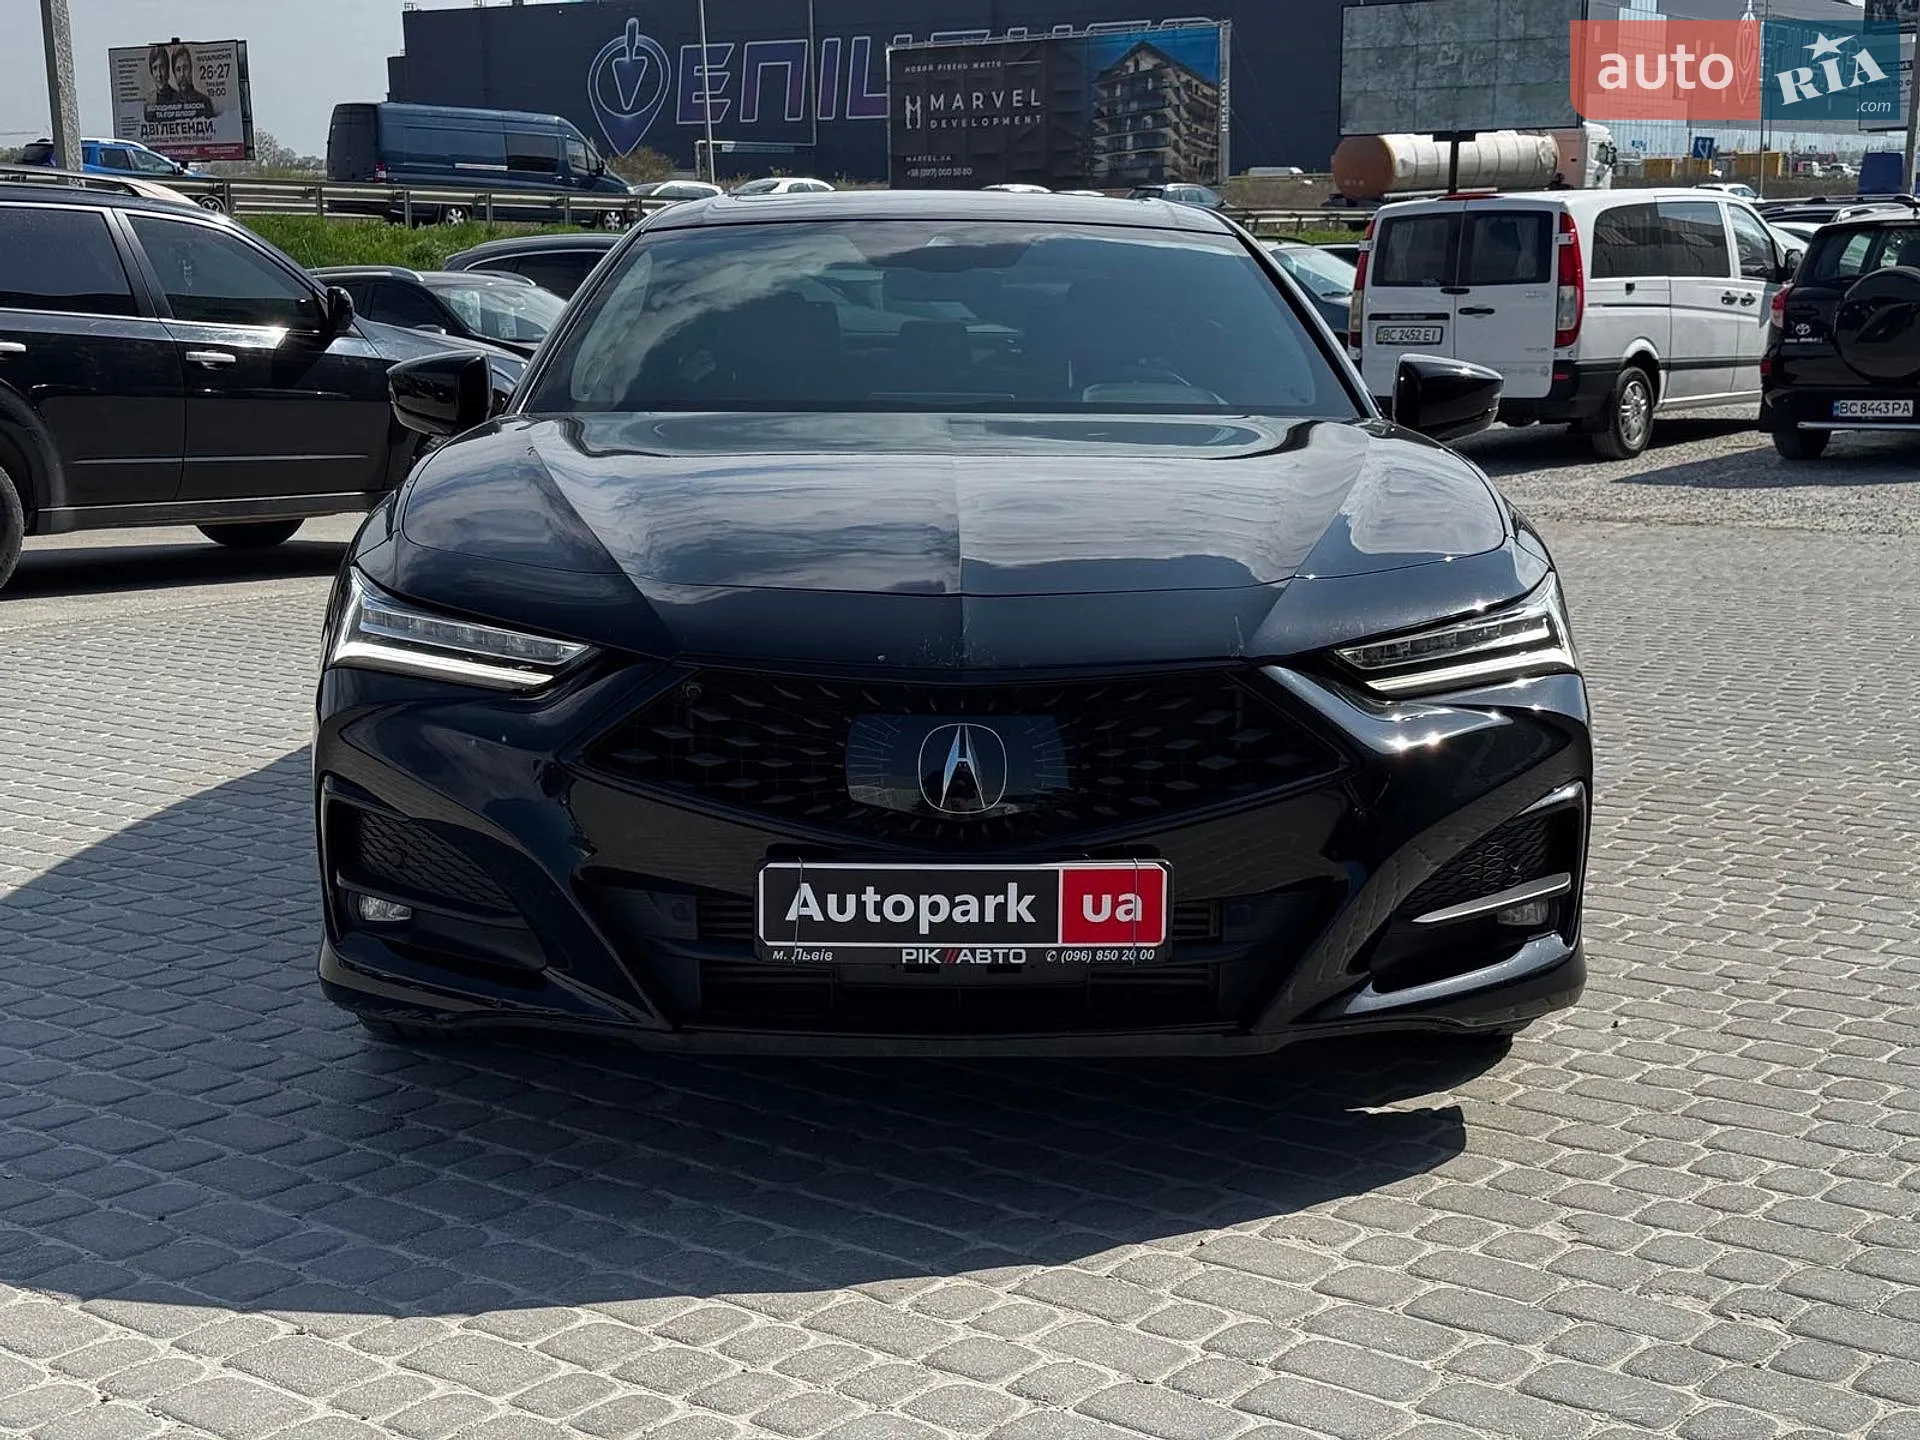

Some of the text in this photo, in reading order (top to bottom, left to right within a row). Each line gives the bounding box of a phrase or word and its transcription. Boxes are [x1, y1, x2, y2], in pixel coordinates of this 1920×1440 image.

[929, 88, 1041, 112] MARVEL
[140, 123, 159, 137] ДВІ
[929, 114, 1041, 130] DEVELOPMENT
[785, 881, 1143, 935] Autopark ua
[1060, 949, 1092, 964] (096)
[1096, 949, 1119, 962] 850
[1139, 949, 1156, 962] 00
